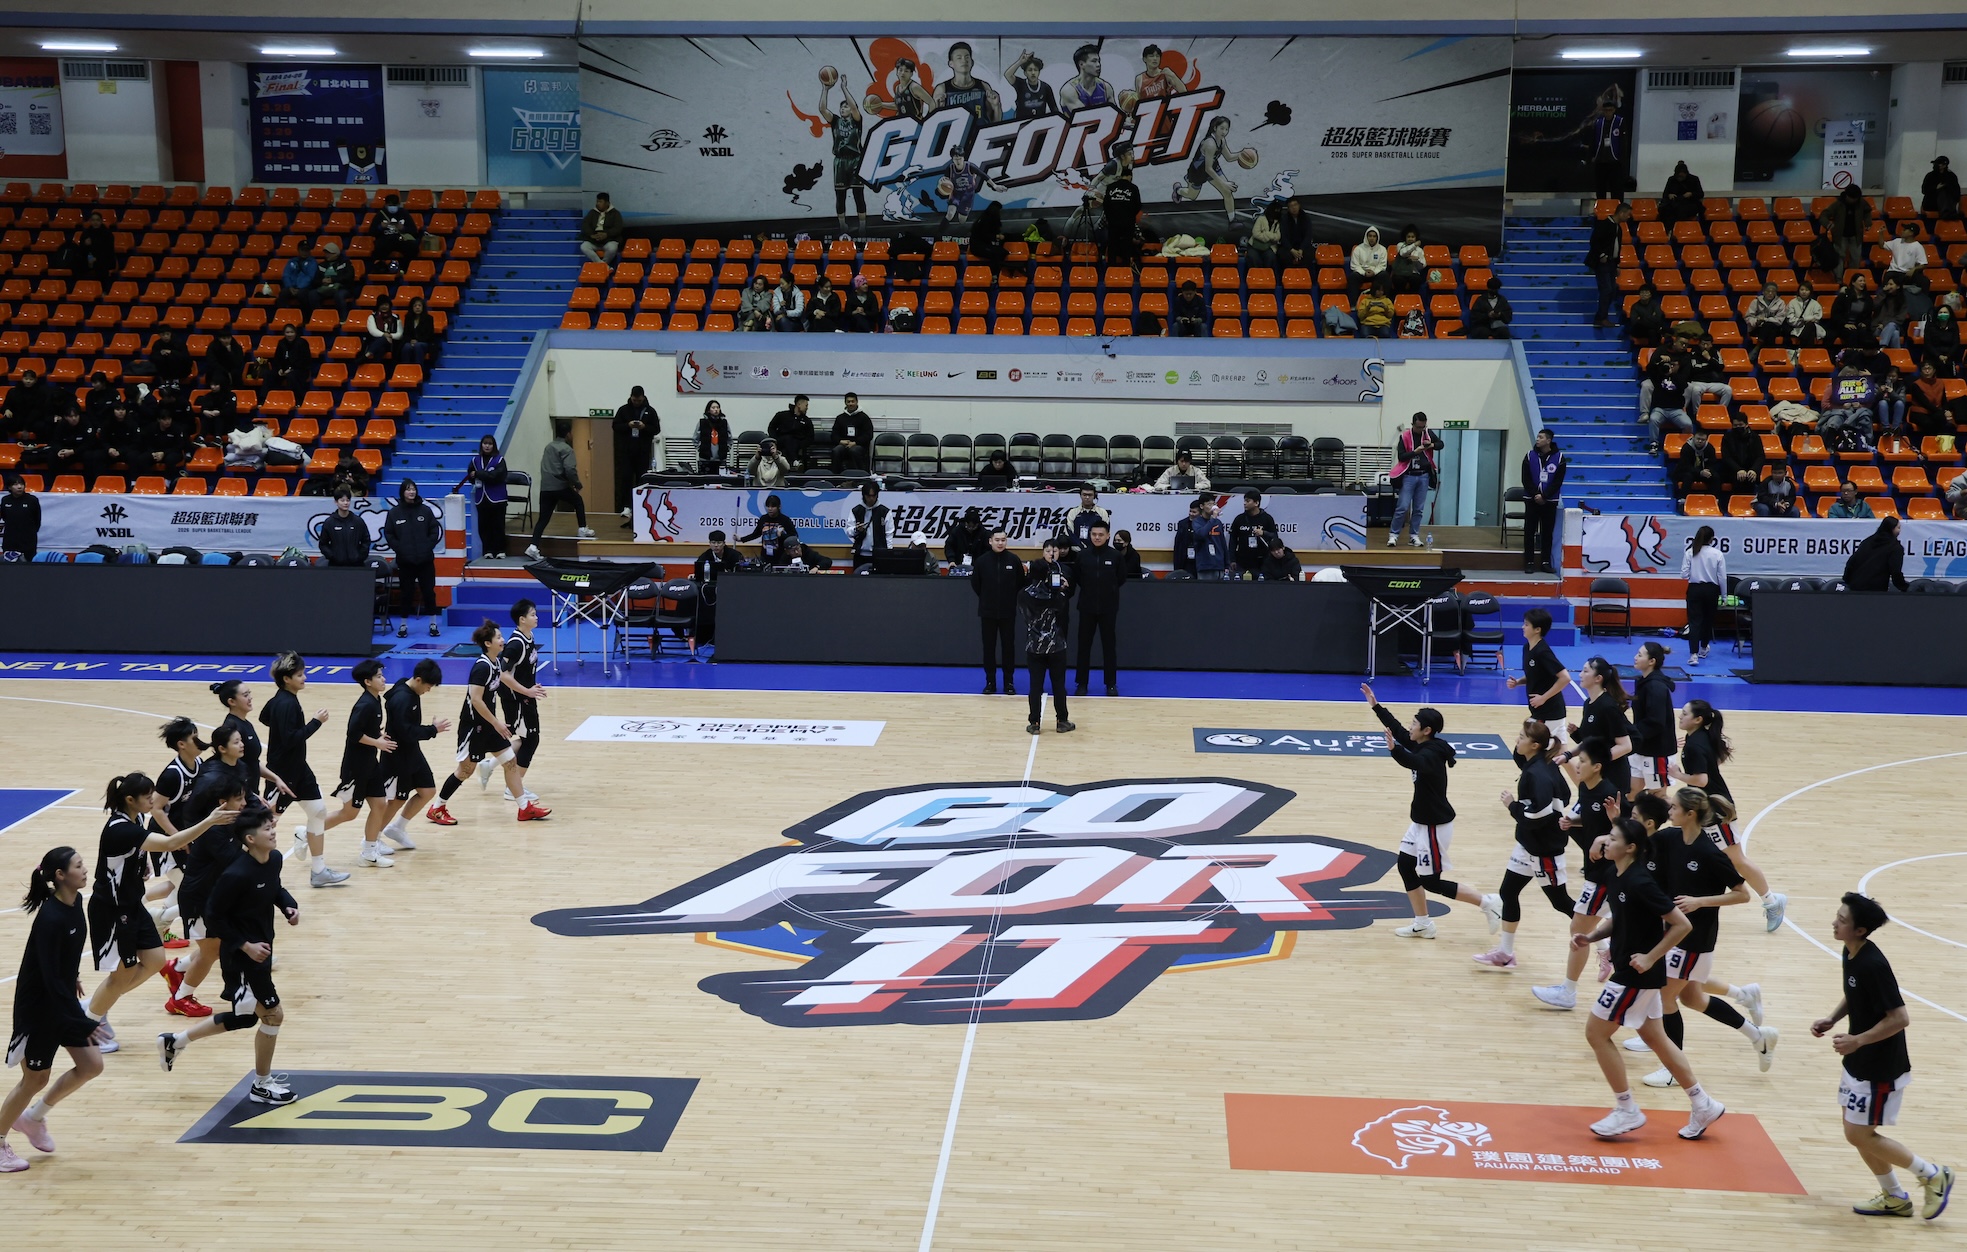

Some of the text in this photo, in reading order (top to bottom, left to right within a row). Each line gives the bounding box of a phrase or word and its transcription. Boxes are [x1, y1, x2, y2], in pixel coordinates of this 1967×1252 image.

[267, 81, 298, 92] Final
[540, 81, 580, 92] 富邦人
[510, 127, 581, 151] 6899
[858, 86, 1225, 191] GO FOR IT
[1320, 127, 1452, 147] 超級籃球聯賽
[699, 147, 734, 157] WSBL
[907, 370, 938, 378] KEELUNG
[170, 511, 260, 526] 超級籃球聯賽
[700, 517, 724, 527] 2026
[824, 518, 849, 528] LEAG
[96, 527, 135, 538] WSBL
[1136, 522, 1161, 532] 2026
[1685, 537, 1730, 554] 226
[1743, 538, 1798, 554] SUPER
[1387, 580, 1421, 589] conti
[120, 663, 266, 674] TAIPEI
[813, 782, 1267, 846] GO
[1417, 853, 1430, 867] 14
[645, 842, 1368, 922] FOR
[780, 920, 1238, 1017] IT
[1669, 953, 1682, 969] 9
[1597, 989, 1616, 1010] 13
[228, 1084, 655, 1136] BC
[1847, 1092, 1867, 1113] 24
[1471, 1150, 1663, 1170] 璞園建築團隊
[1474, 1161, 1621, 1176] PAUIAN ARCHILAND
